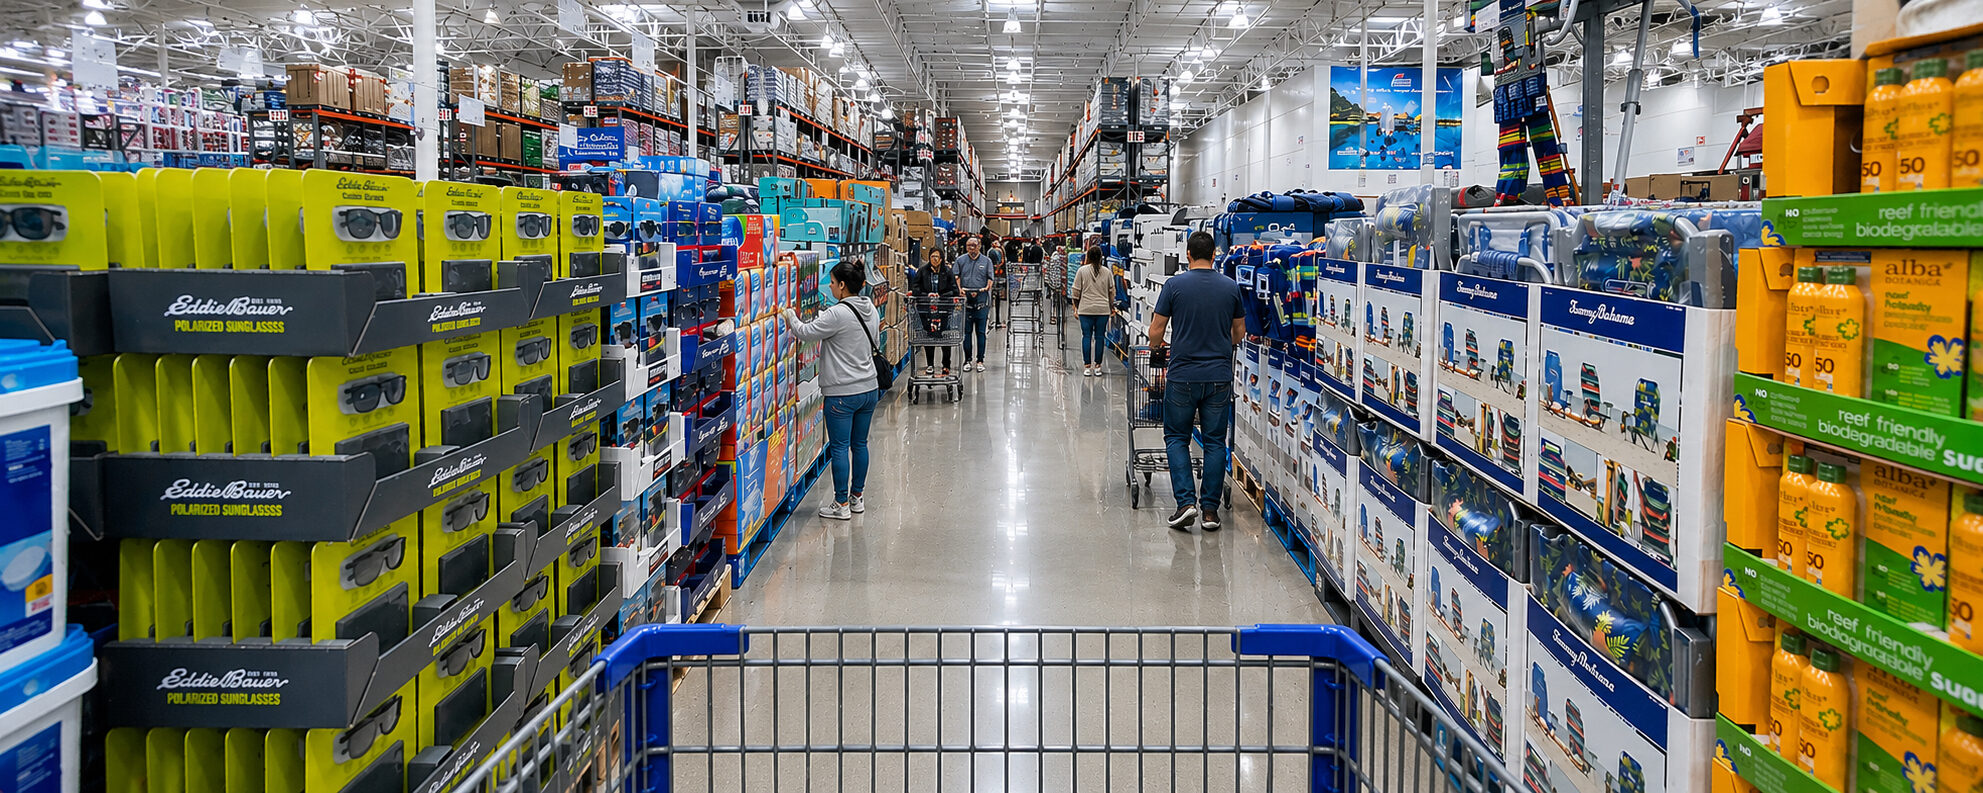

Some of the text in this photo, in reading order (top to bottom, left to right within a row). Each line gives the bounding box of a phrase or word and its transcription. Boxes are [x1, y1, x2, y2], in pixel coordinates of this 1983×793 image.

[1900, 157, 1925, 174] 50
[1879, 203, 1914, 220] reef
[1885, 259, 1942, 277] alba
[174, 319, 224, 333] POLARIZED
[1815, 357, 1835, 374] 50
[1838, 409, 1870, 427] reef
[1876, 415, 1946, 449] friendly
[1874, 465, 1929, 490] alba
[170, 503, 221, 516] POLARIZED
[1827, 608, 1934, 671] reef friendly
[167, 692, 219, 705] POLARIZED
